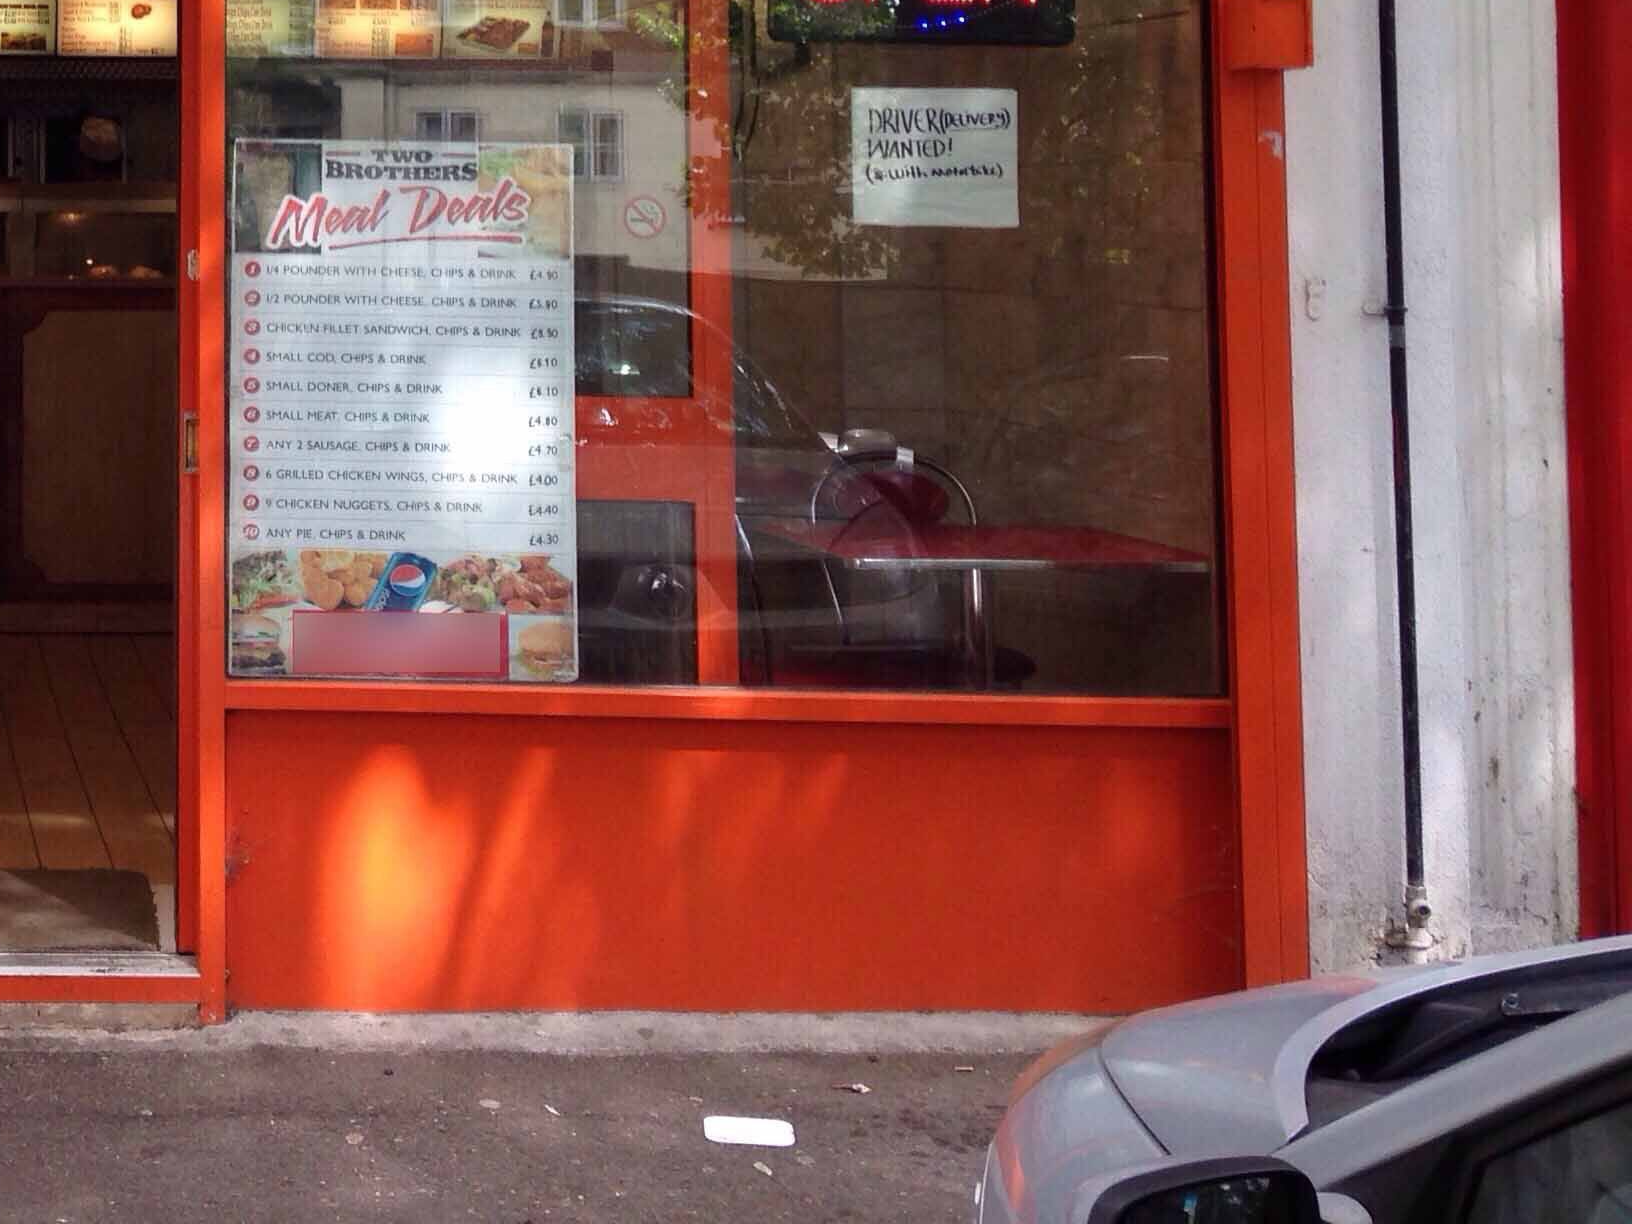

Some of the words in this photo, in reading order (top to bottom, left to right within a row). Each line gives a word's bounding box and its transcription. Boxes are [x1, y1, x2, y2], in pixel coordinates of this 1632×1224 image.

[370, 149, 433, 164] TWO
[325, 159, 478, 182] BROTHERS
[267, 188, 391, 245] Meal
[398, 178, 529, 235] Deals
[284, 264, 340, 275] POUNDER
[345, 266, 377, 276] WITH
[431, 268, 464, 277] CHIPS
[469, 269, 476, 278] &
[480, 269, 516, 279] DRINK
[266, 294, 280, 304] 1/2
[284, 294, 341, 305] POUNDER
[345, 295, 377, 305] WITH
[431, 297, 465, 307] CHIPS
[469, 298, 476, 307] &
[481, 298, 517, 308] DRINK
[266, 322, 319, 334] CHICKEN
[323, 324, 358, 334] FILLET
[435, 326, 468, 337] CHIPS
[472, 327, 480, 336] &
[485, 327, 520, 338] DRINK
[266, 351, 303, 362] SMALL
[341, 353, 374, 364] CHIPS
[377, 354, 385, 364] &
[390, 354, 426, 365] DRINK
[266, 381, 303, 392] SMALL
[357, 383, 390, 393] CHIPS
[394, 384, 402, 393] &
[406, 384, 443, 394] DRINK
[266, 410, 303, 421] SMALL
[344, 411, 378, 422] CHIPS
[381, 412, 389, 422] &
[393, 412, 430, 423] DRINK
[266, 439, 292, 450] ANY
[297, 440, 303, 449] 2
[365, 441, 398, 452] CHIPS
[402, 442, 410, 452] &
[415, 442, 450, 453] DRINK
[276, 469, 323, 480] GRILLED
[328, 470, 381, 481] CHICKEN
[386, 471, 428, 483] WINGS,
[431, 472, 464, 482] CHIPS
[468, 473, 476, 483] &
[481, 473, 518, 484] DRINK
[276, 498, 329, 509] CHICKEN
[333, 499, 393, 511] NUGGETS,
[397, 501, 430, 511] CHIPS
[434, 502, 442, 512] &
[446, 502, 483, 513] DRINK
[266, 528, 292, 538] ANY
[320, 529, 353, 539] CHIPS
[357, 530, 365, 540] &
[369, 530, 406, 541] DRINK
